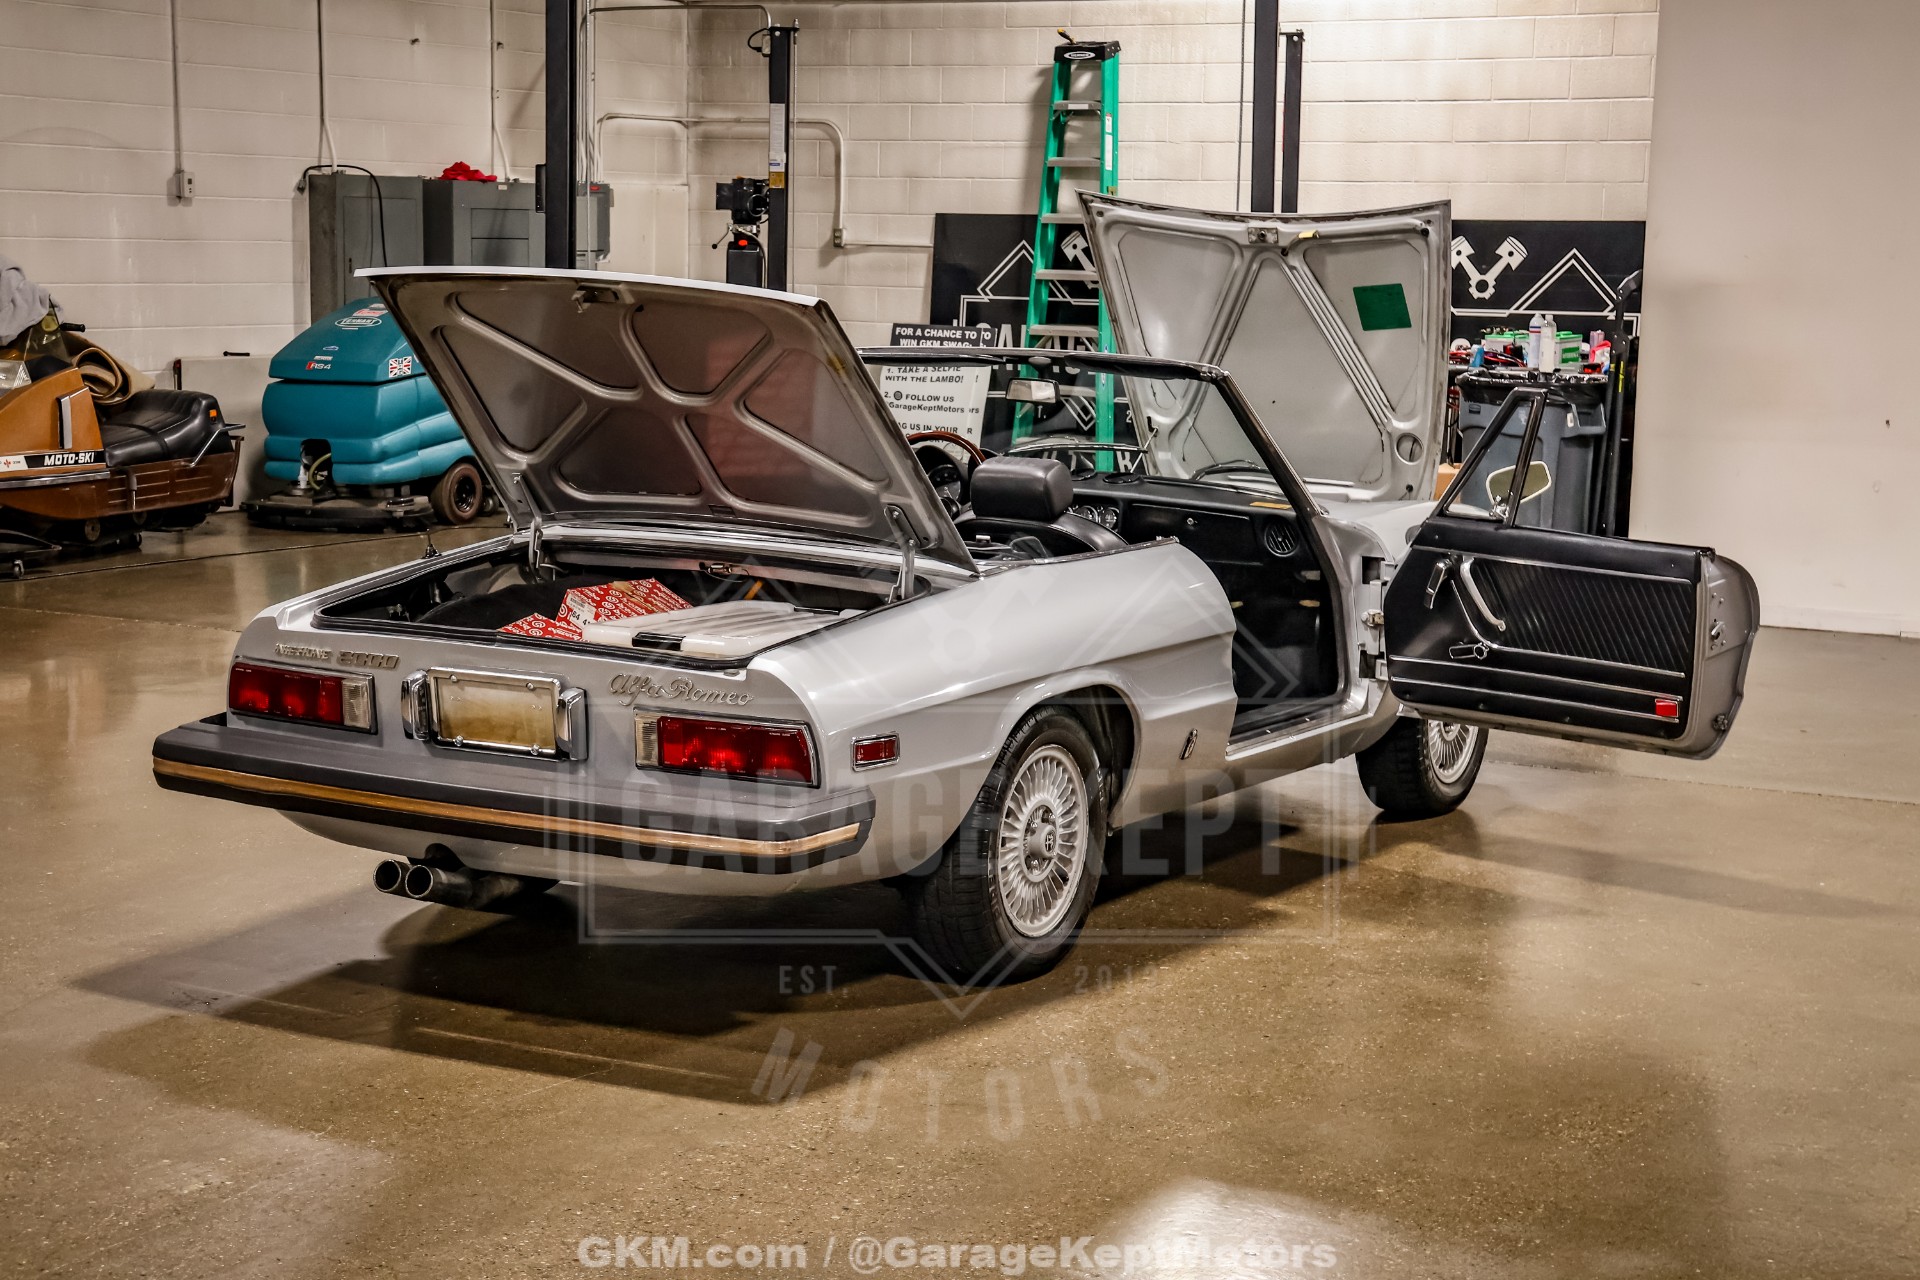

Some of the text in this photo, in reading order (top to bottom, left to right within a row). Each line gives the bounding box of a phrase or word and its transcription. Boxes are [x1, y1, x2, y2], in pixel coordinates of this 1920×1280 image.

[895, 327, 914, 336] FOR
[924, 329, 962, 339] CHANCE
[964, 331, 977, 339] TO
[900, 338, 918, 347] WIN
[898, 366, 921, 374] TAKE
[929, 376, 964, 384] LAMBO!
[884, 391, 892, 399] 2.
[905, 393, 941, 402] FOLLOW
[887, 401, 964, 413] GarageKeptMotors
[909, 422, 921, 431] US
[608, 672, 755, 707] Alfa Romeo
